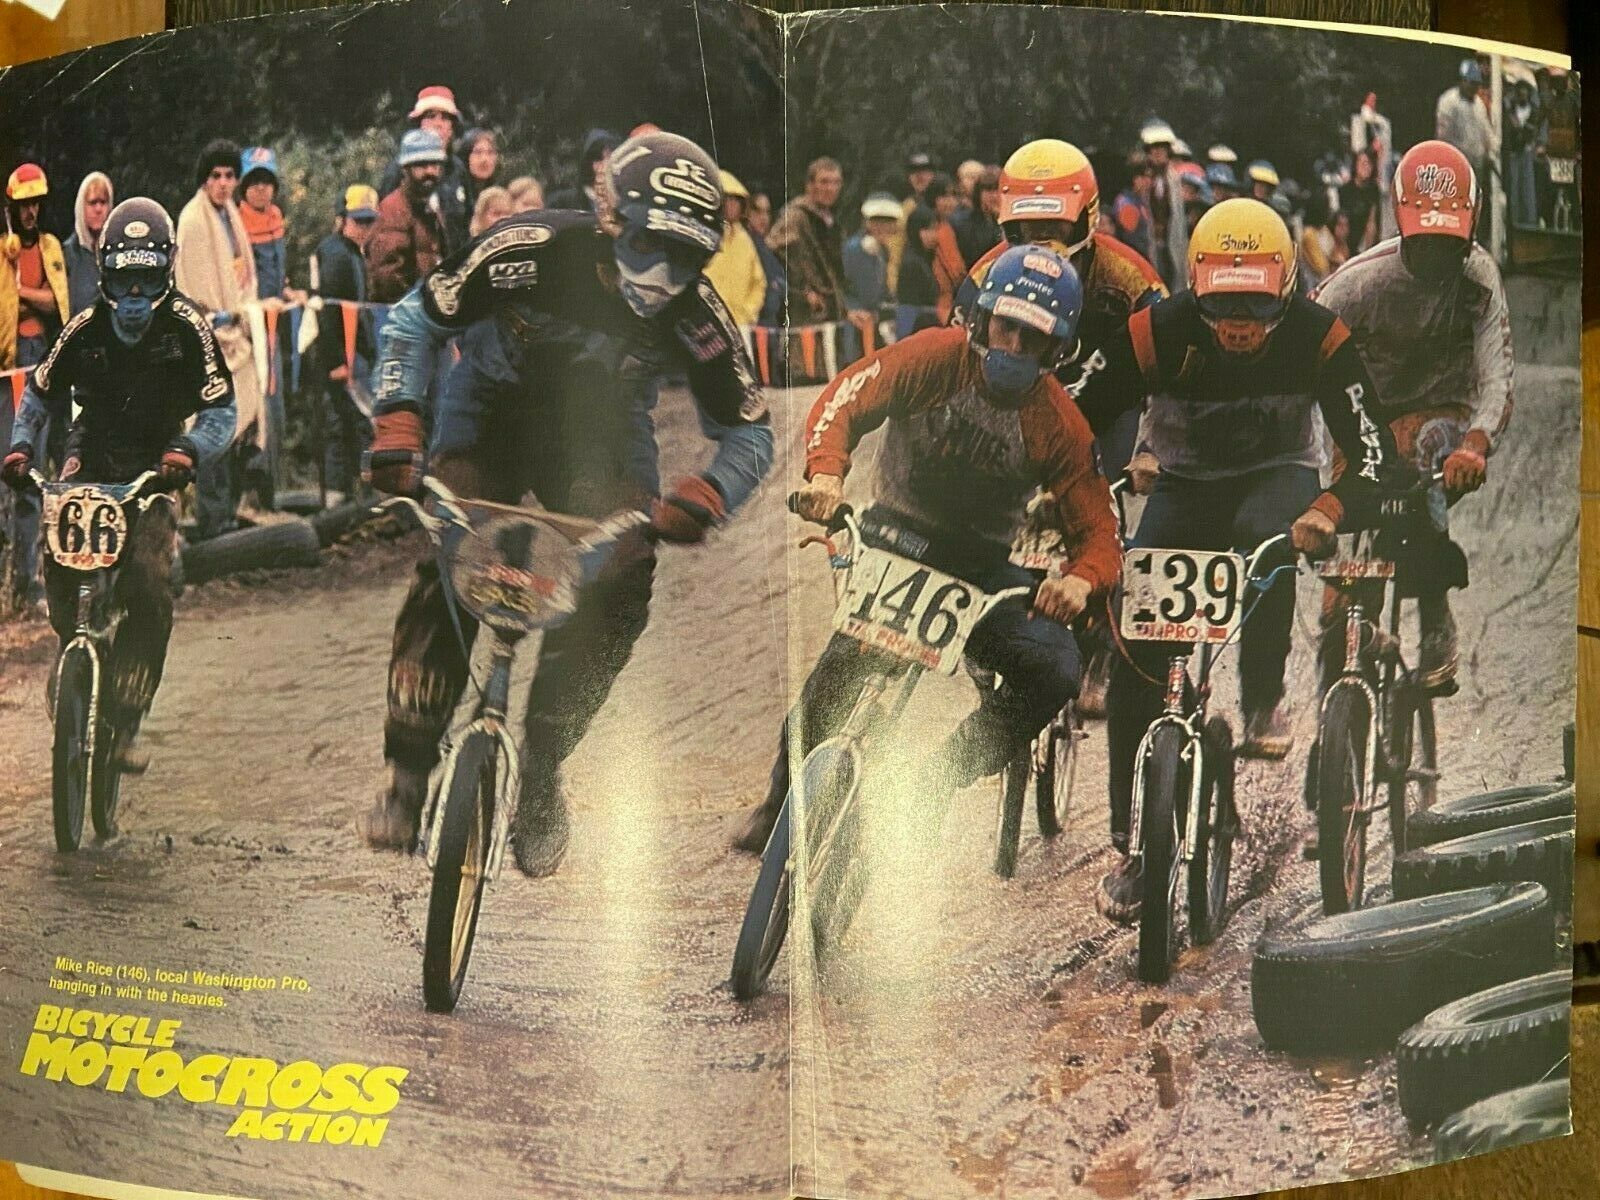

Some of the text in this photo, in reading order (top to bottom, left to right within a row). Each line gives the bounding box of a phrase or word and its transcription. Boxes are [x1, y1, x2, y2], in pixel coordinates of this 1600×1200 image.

[58, 501, 118, 554] 66
[848, 560, 972, 650] 146
[1131, 552, 1238, 627] 139
[1164, 623, 1199, 639] PRO
[49, 976, 228, 1008] hanging in with the heavies.
[55, 956, 312, 993] Mike Rice (146), local Washington Pro,
[33, 1004, 182, 1048] BICYCLE
[20, 1032, 410, 1115] MOTOCROSS
[224, 1109, 389, 1147] ACTION
